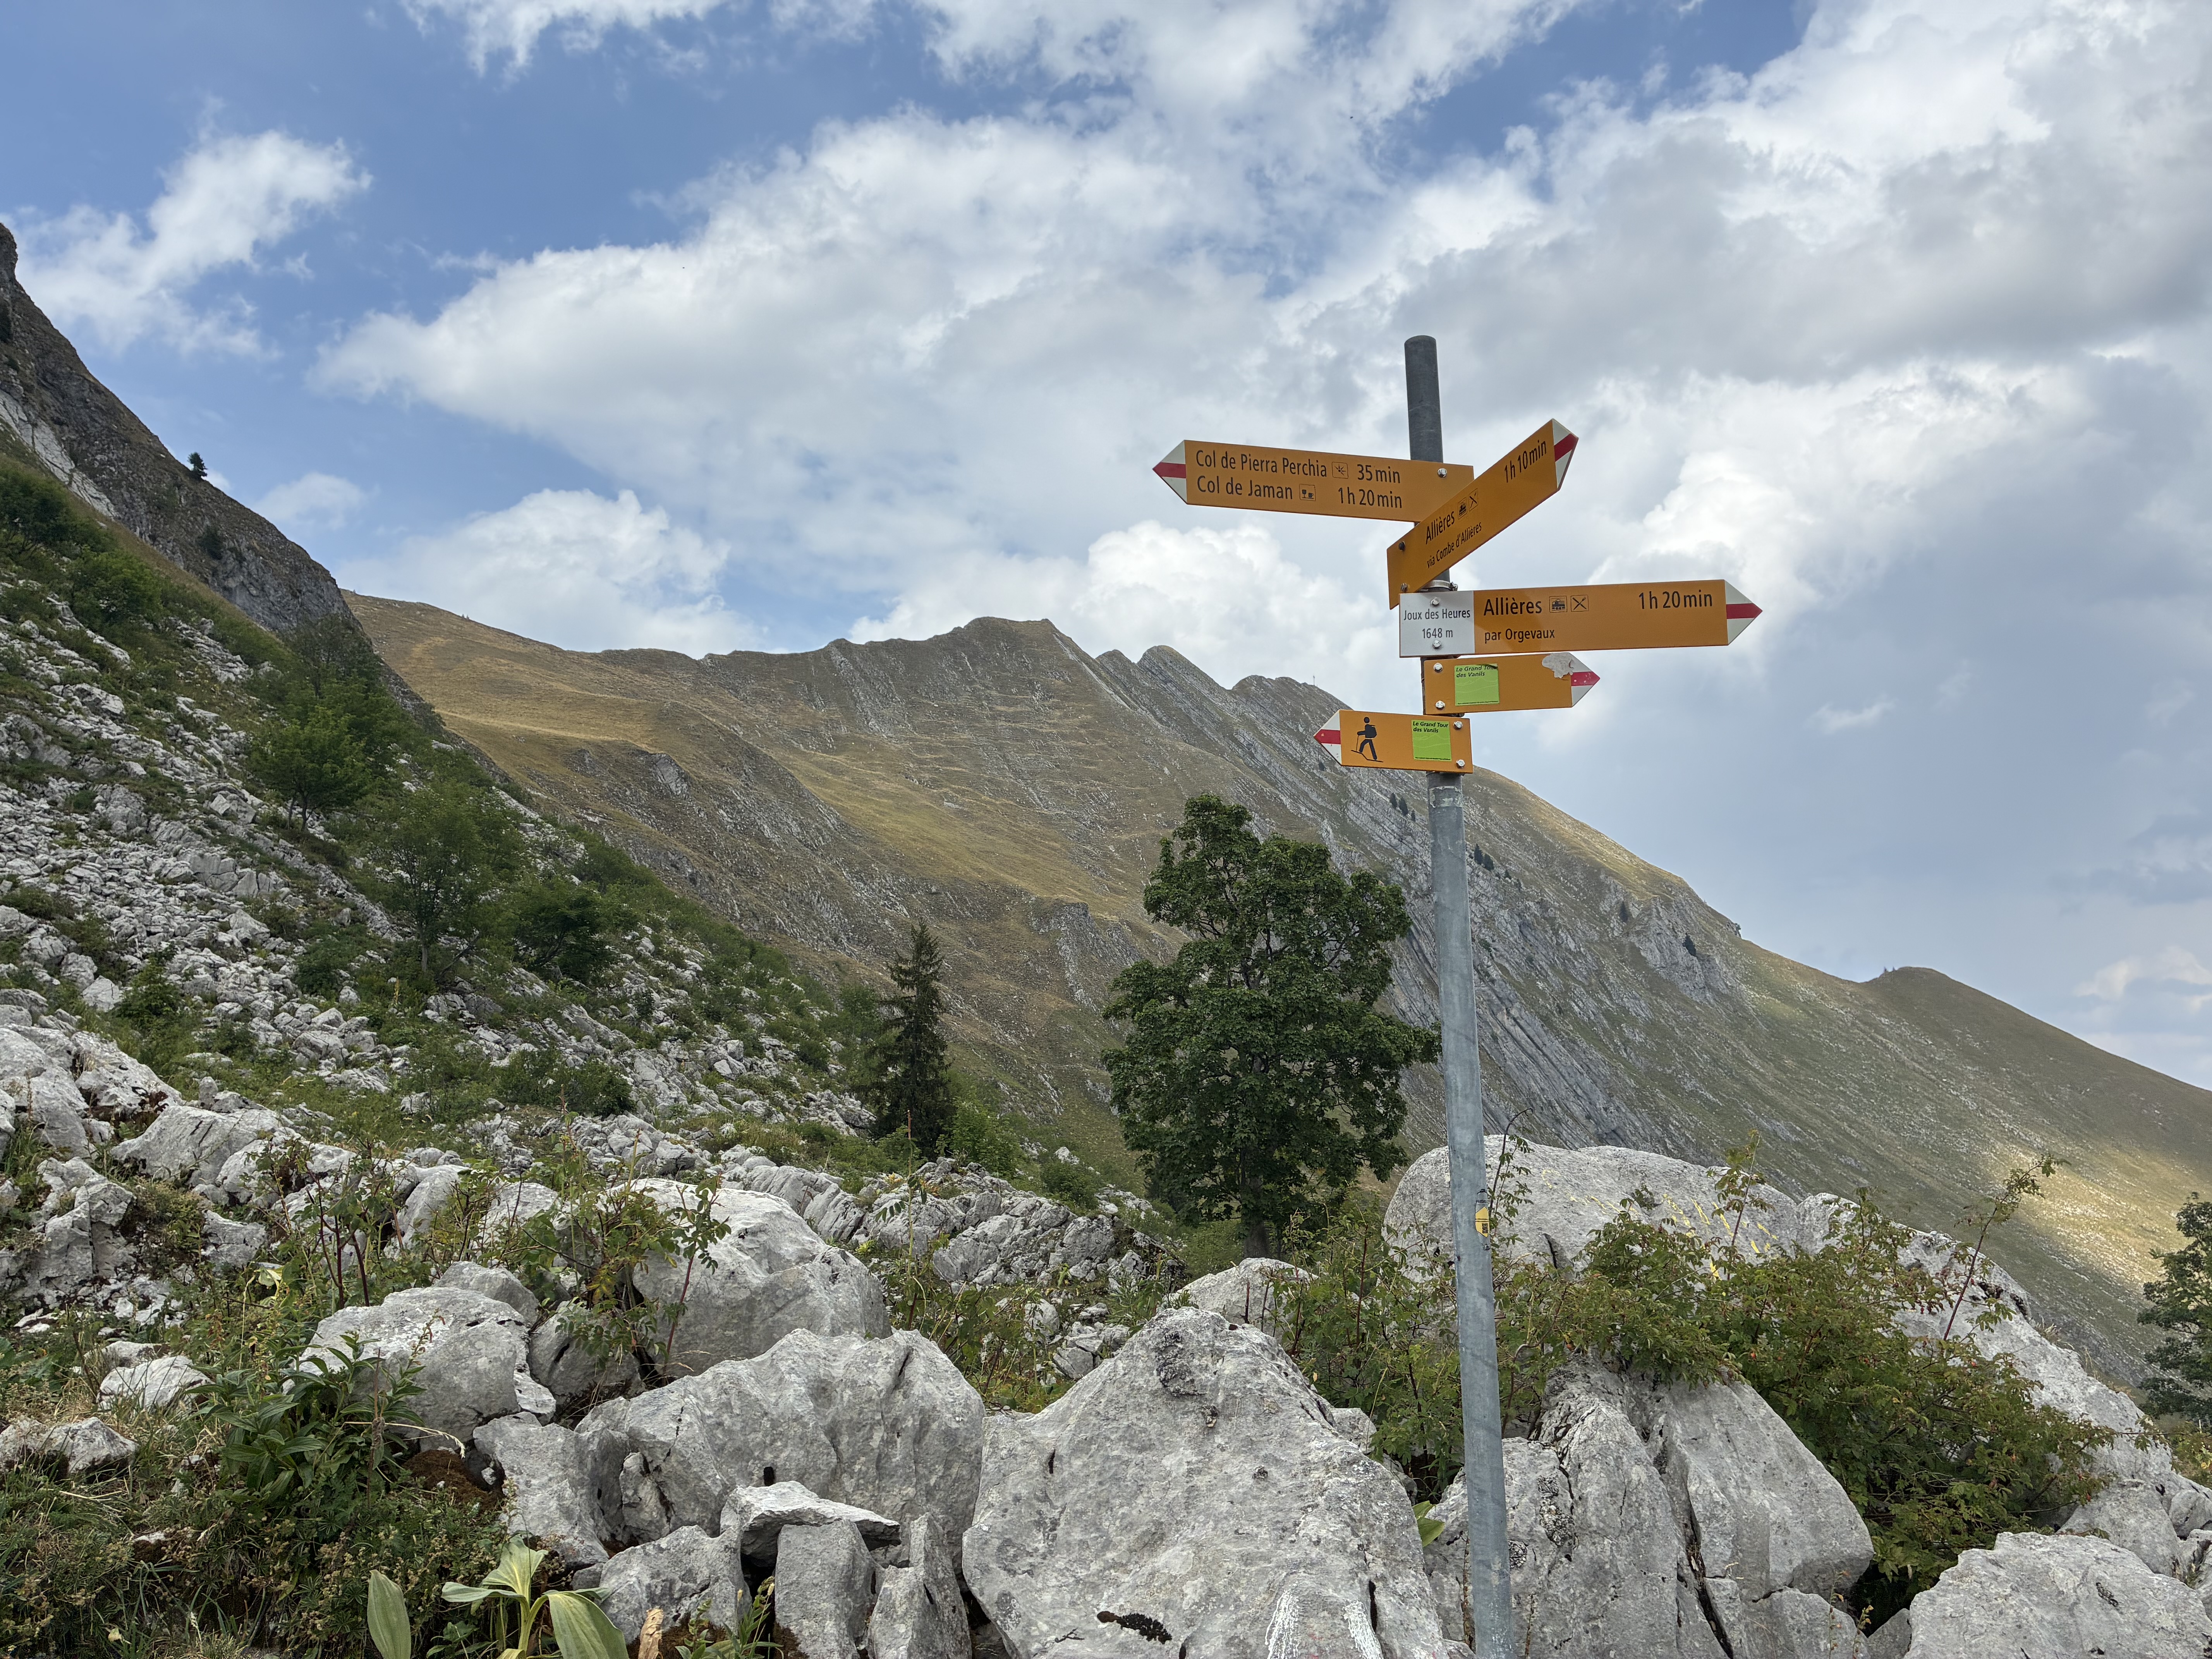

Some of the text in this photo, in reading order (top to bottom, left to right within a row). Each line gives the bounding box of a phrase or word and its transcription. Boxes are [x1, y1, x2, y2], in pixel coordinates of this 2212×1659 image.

[1196, 449, 1327, 477] Col de Pierra Perchia
[1197, 475, 1293, 500] Col de Jaman
[1425, 511, 1455, 545] Allières
[1427, 522, 1482, 568] via Combe d'Allières
[1404, 608, 1471, 620] Joux des Heures
[1484, 597, 1542, 616] Allières
[1422, 628, 1453, 639] 1648 m
[1484, 628, 1555, 644] par Orgevaux
